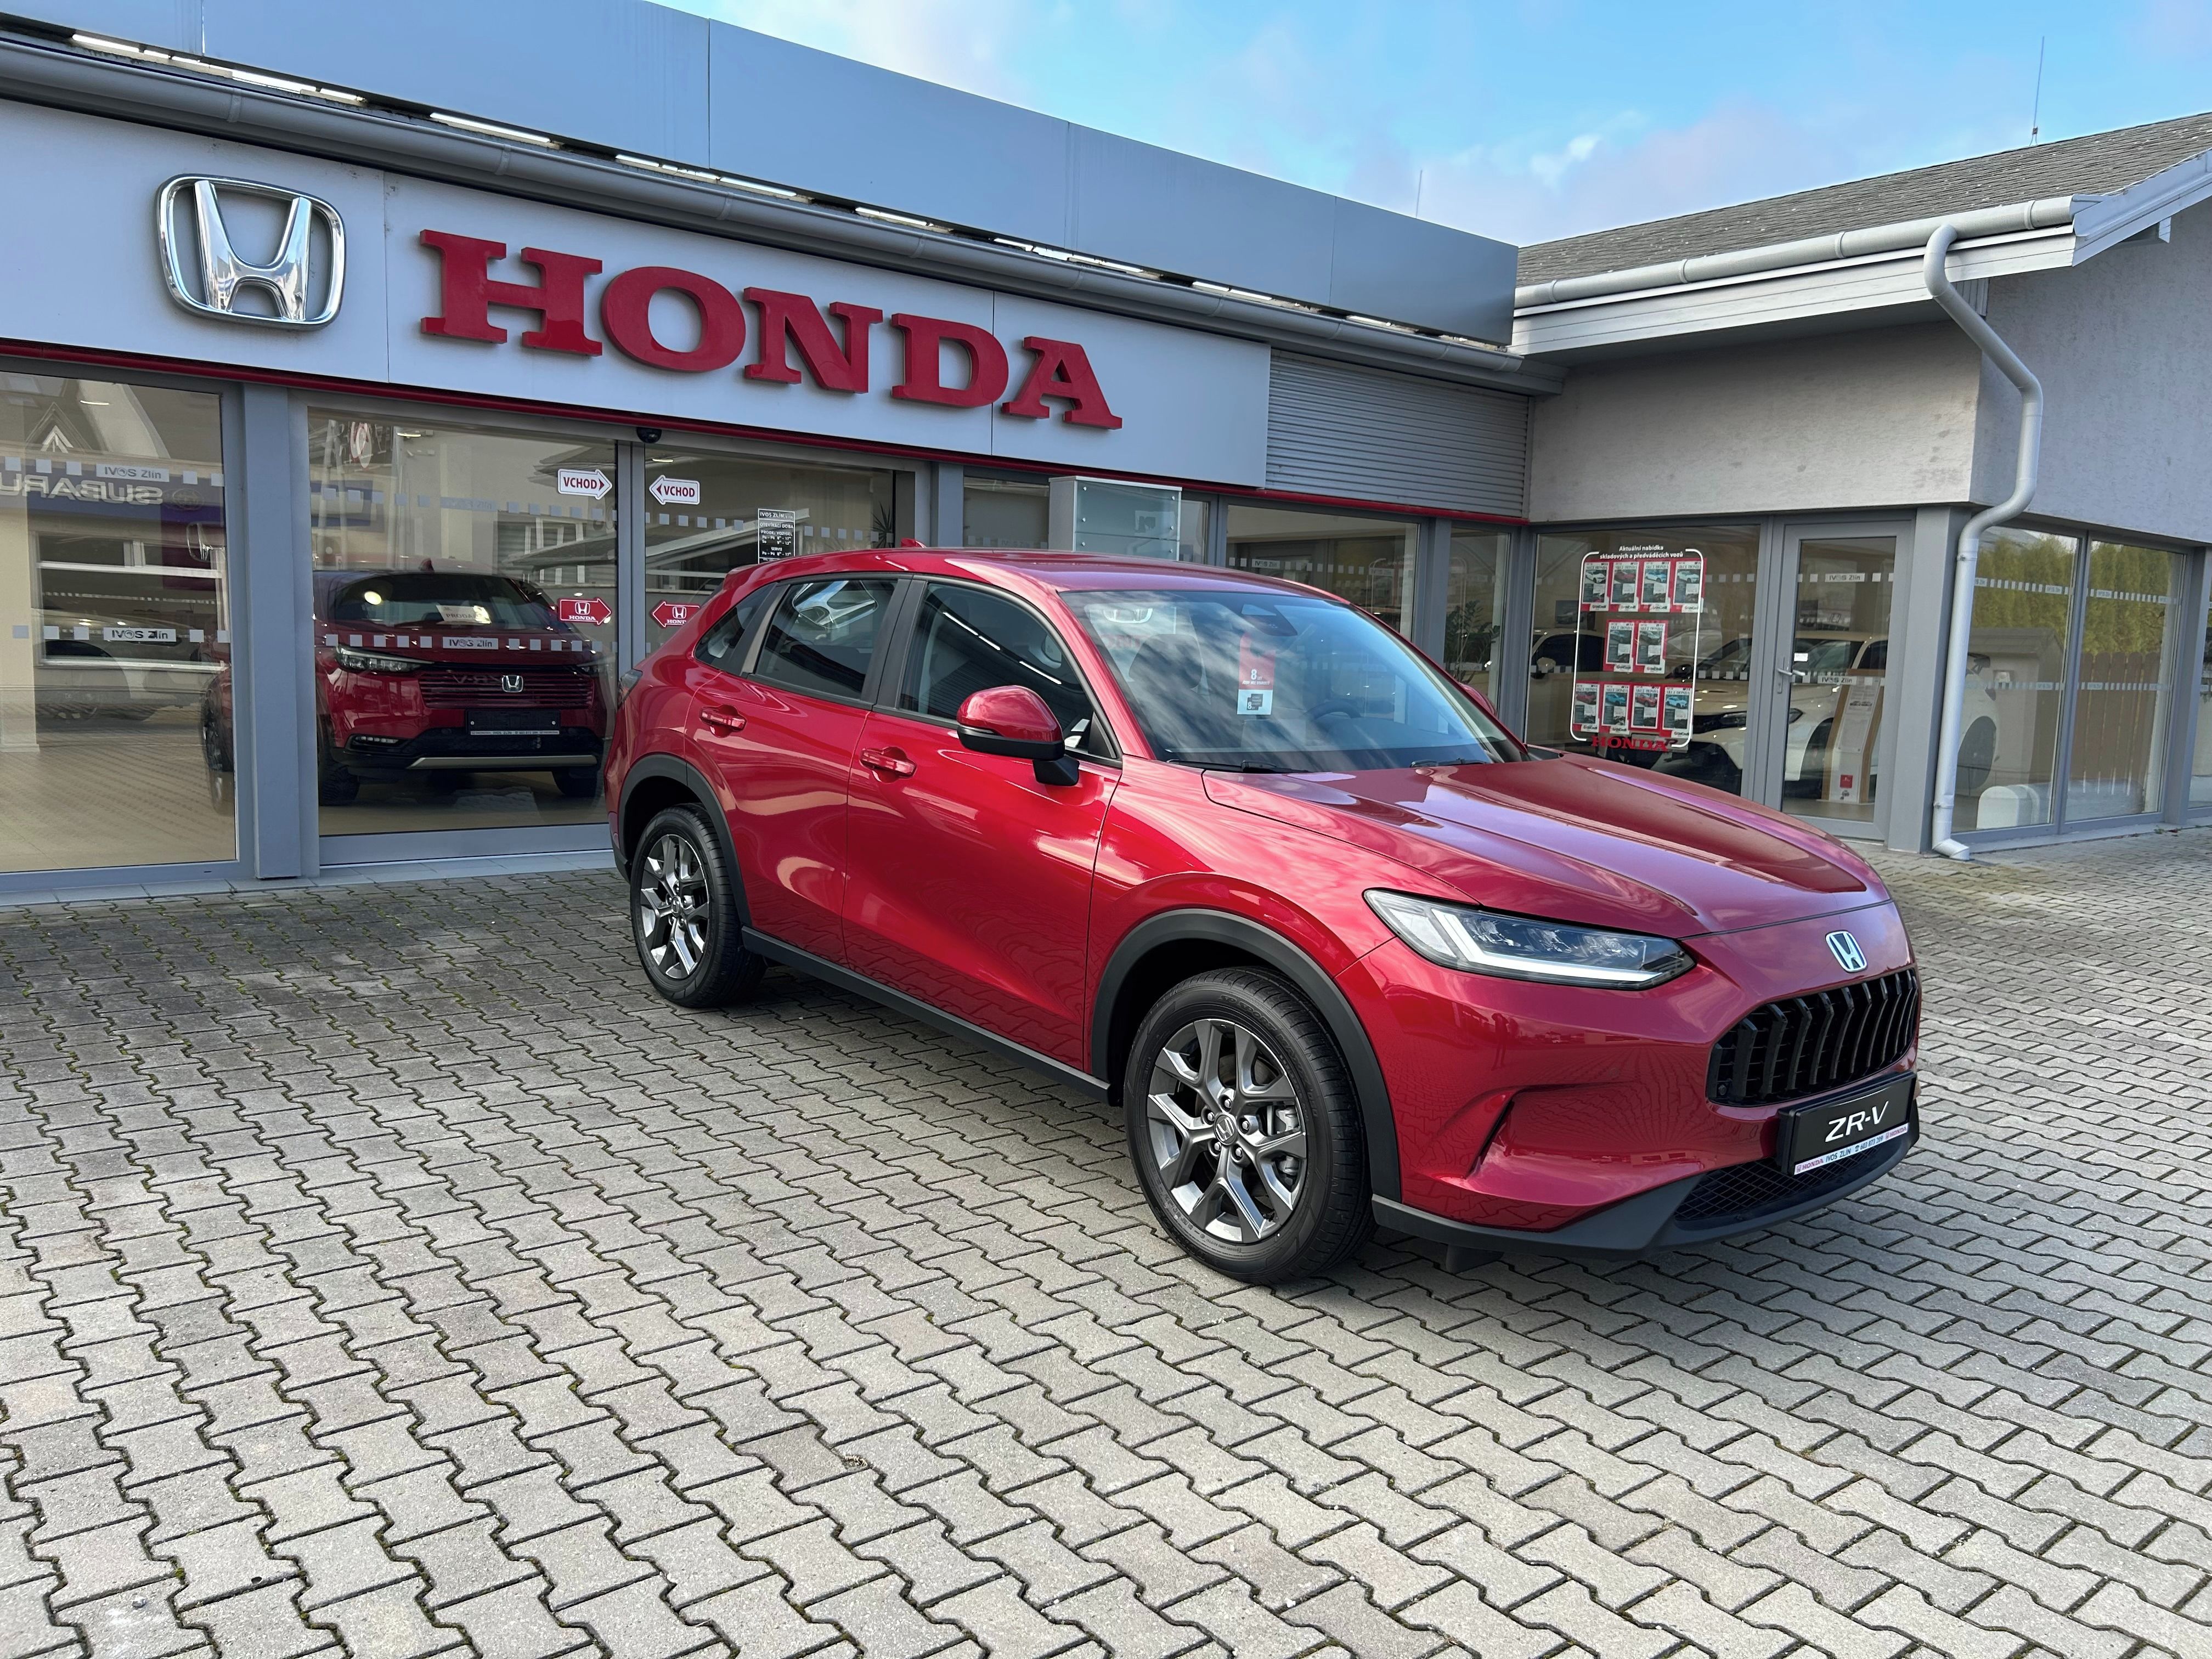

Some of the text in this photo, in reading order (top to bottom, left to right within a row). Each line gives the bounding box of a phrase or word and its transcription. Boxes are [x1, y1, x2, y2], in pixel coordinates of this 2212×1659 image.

[420, 229, 1122, 430] HONDA
[141, 469, 161, 479] Zlín
[563, 477, 597, 489] VCHOD
[664, 486, 695, 498] VCHOD
[477, 639, 492, 647] Zlín
[1251, 669, 1257, 680] 8
[1592, 735, 1668, 752] HONDA
[1825, 1101, 1889, 1142] ZR-V
[1802, 1159, 1824, 1170] HONDA
[1826, 1154, 1837, 1163] IVOS
[1839, 1148, 1851, 1158] ZLÍN
[1889, 1127, 1906, 1136] HONDA
